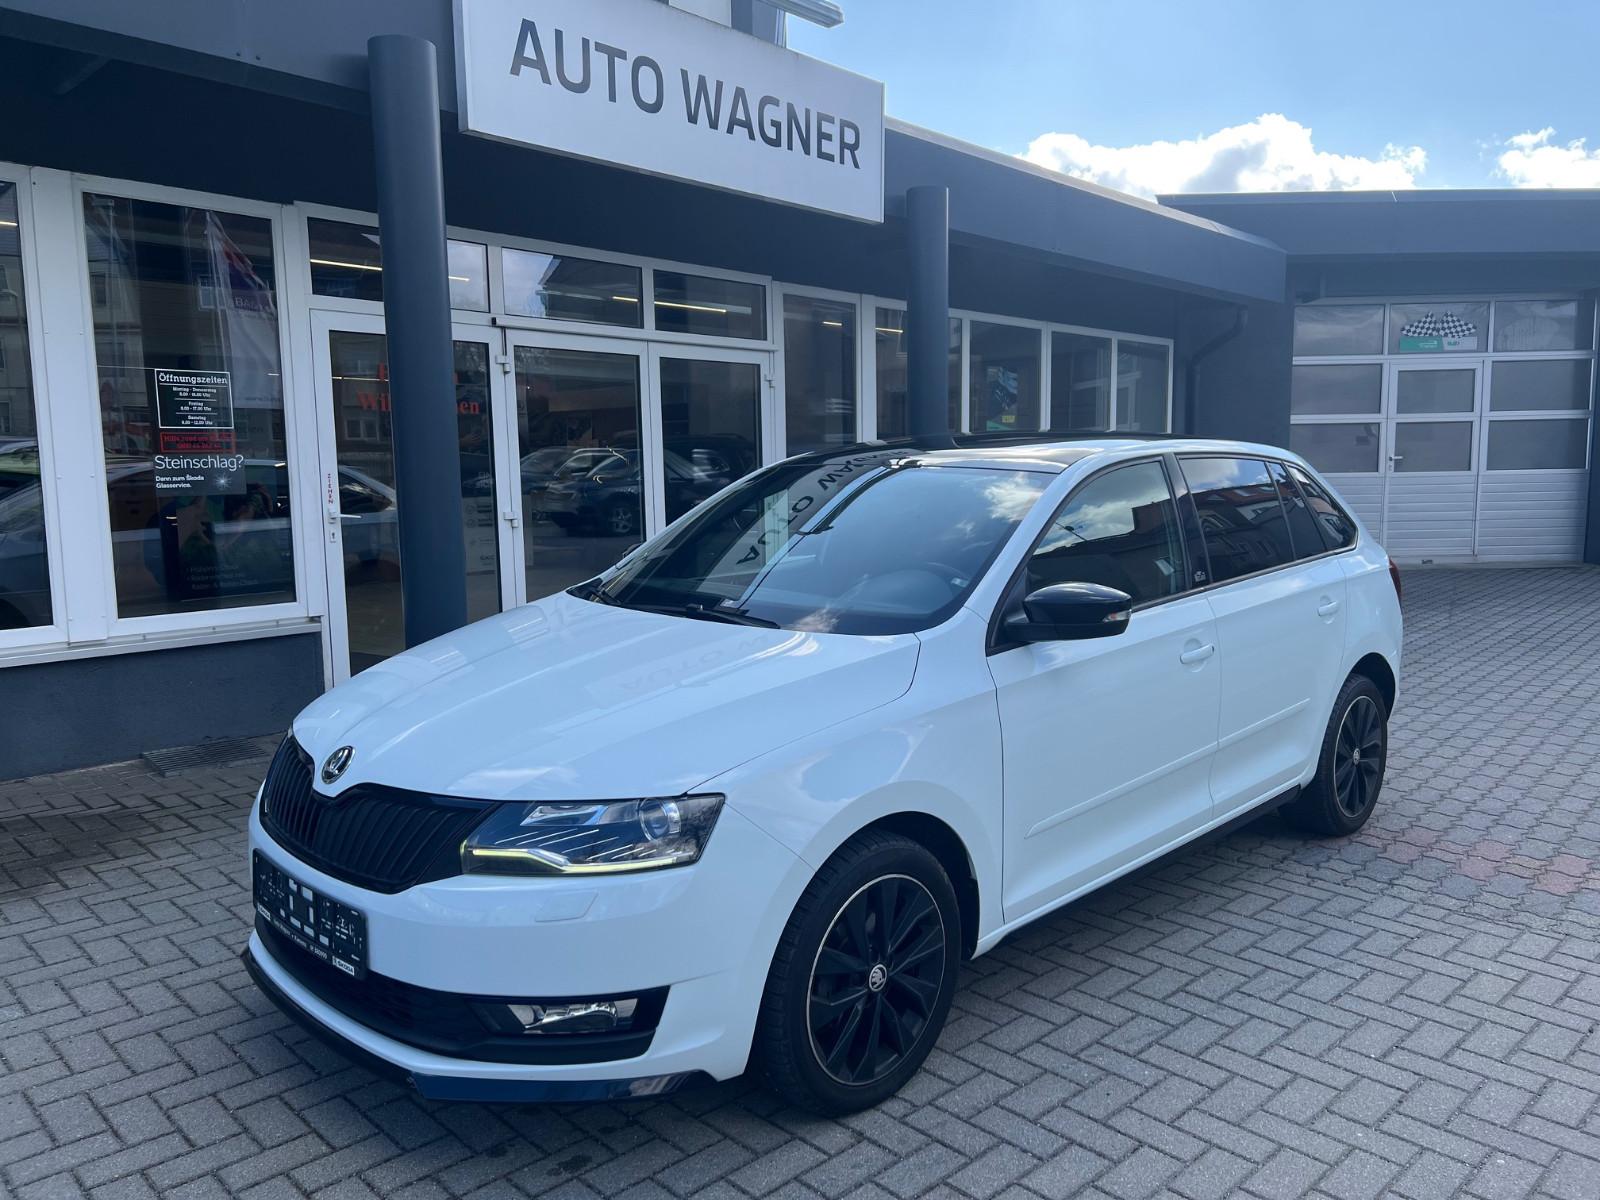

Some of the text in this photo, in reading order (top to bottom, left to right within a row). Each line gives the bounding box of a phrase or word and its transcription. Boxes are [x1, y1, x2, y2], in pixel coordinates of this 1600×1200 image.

[510, 17, 862, 170] AUTO WAGNER
[158, 372, 228, 384] Öffnungszeiten
[154, 454, 244, 472] Steinschlag?
